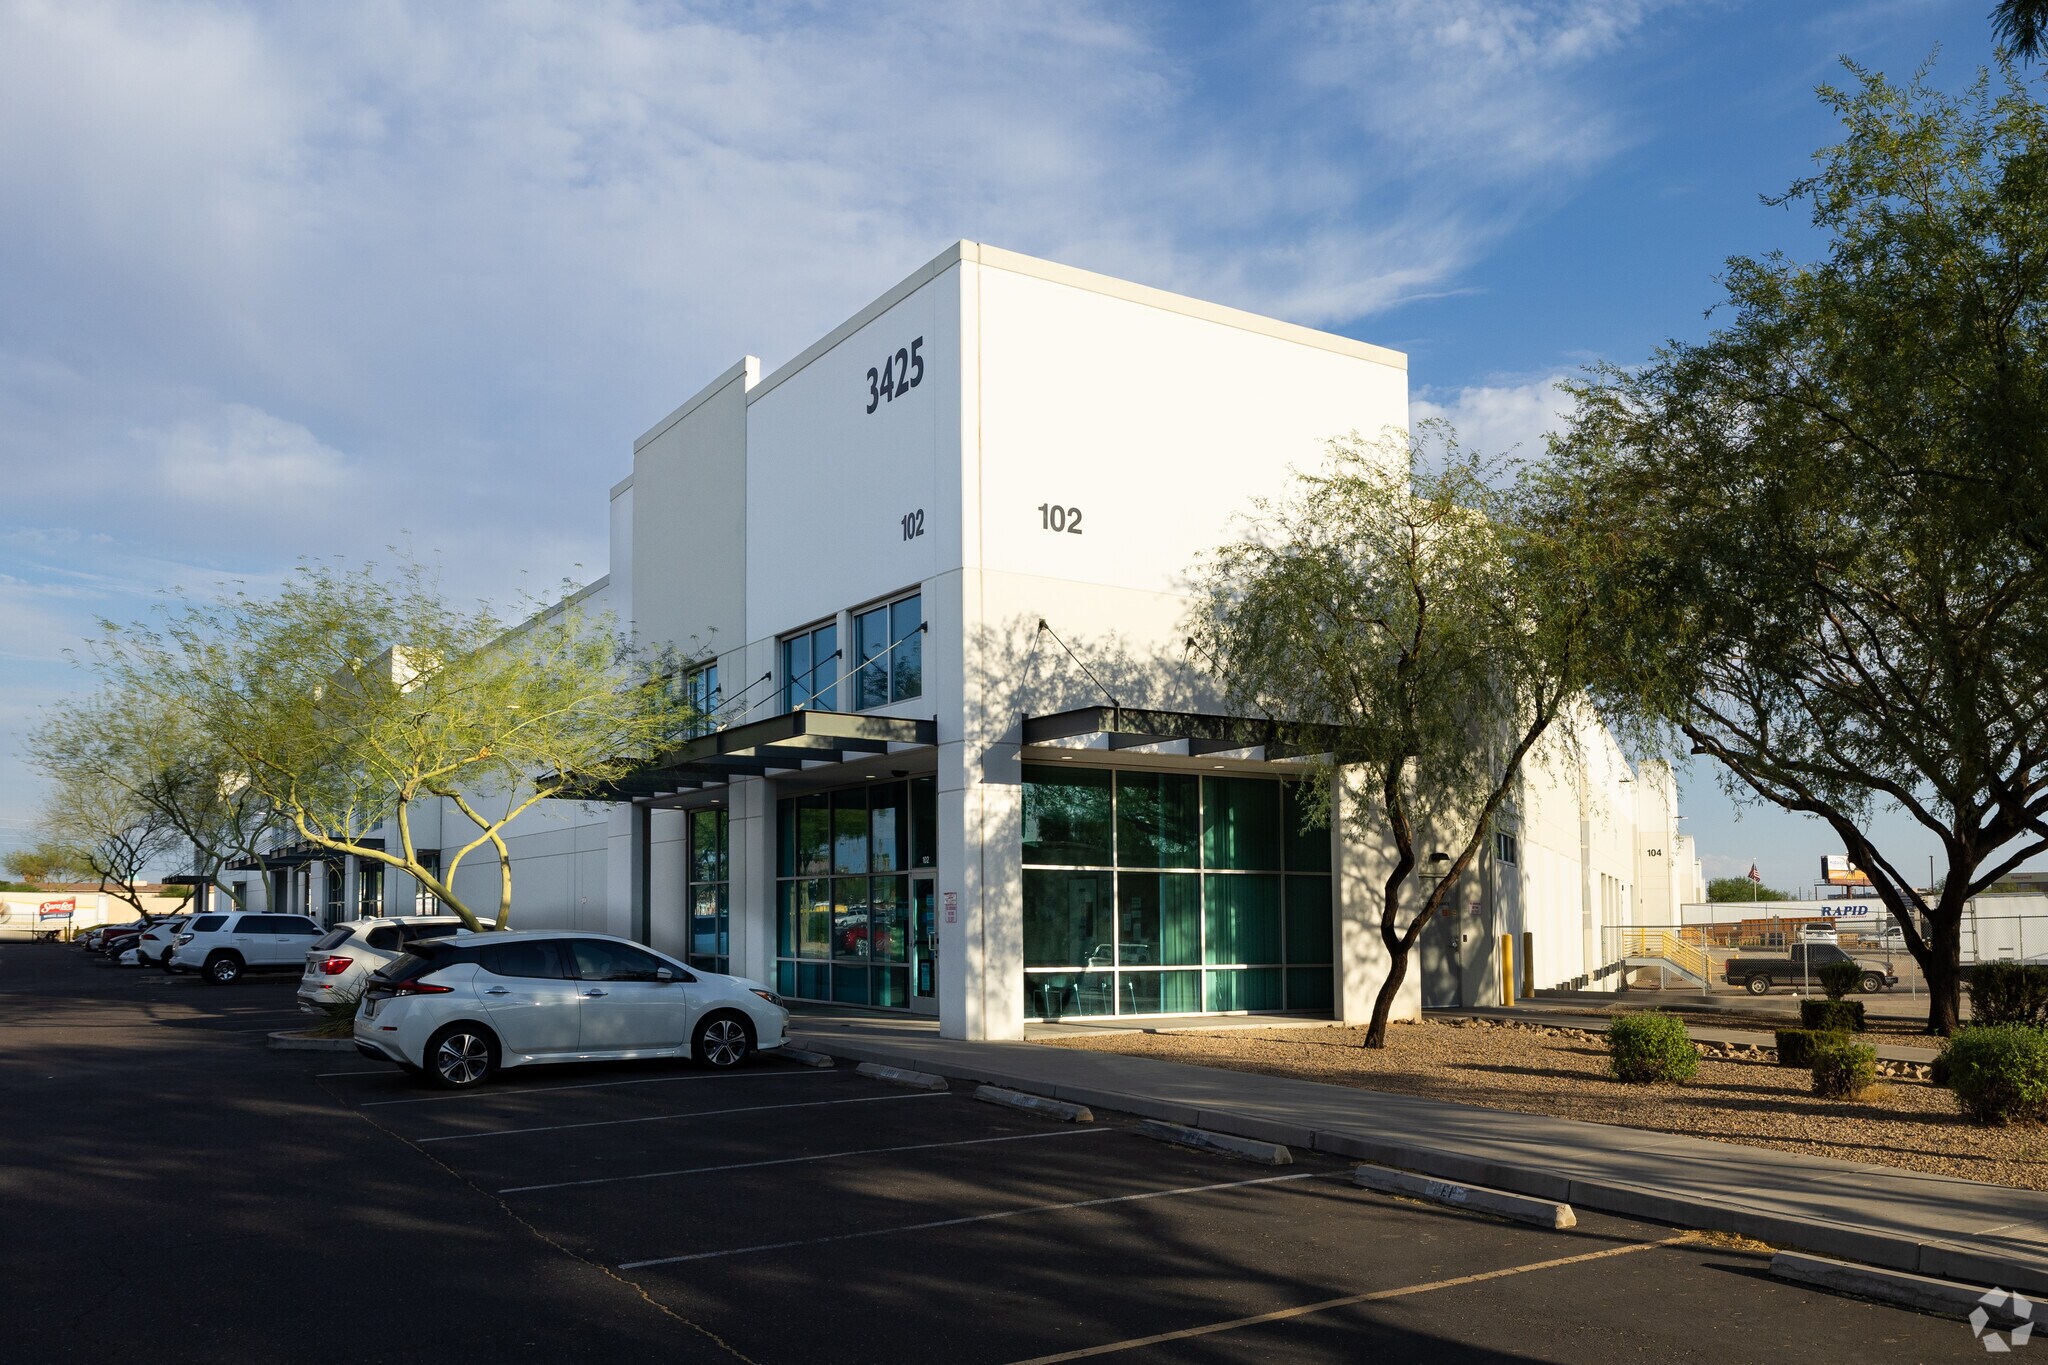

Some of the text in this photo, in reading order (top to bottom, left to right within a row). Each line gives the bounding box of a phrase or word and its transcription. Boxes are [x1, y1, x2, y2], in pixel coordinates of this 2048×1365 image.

[866, 335, 924, 415] 3425
[900, 508, 925, 542] 102
[1037, 502, 1083, 535] 102
[922, 855, 930, 863] 102
[1647, 848, 1662, 857] 104
[1821, 905, 1868, 916] RAPID
